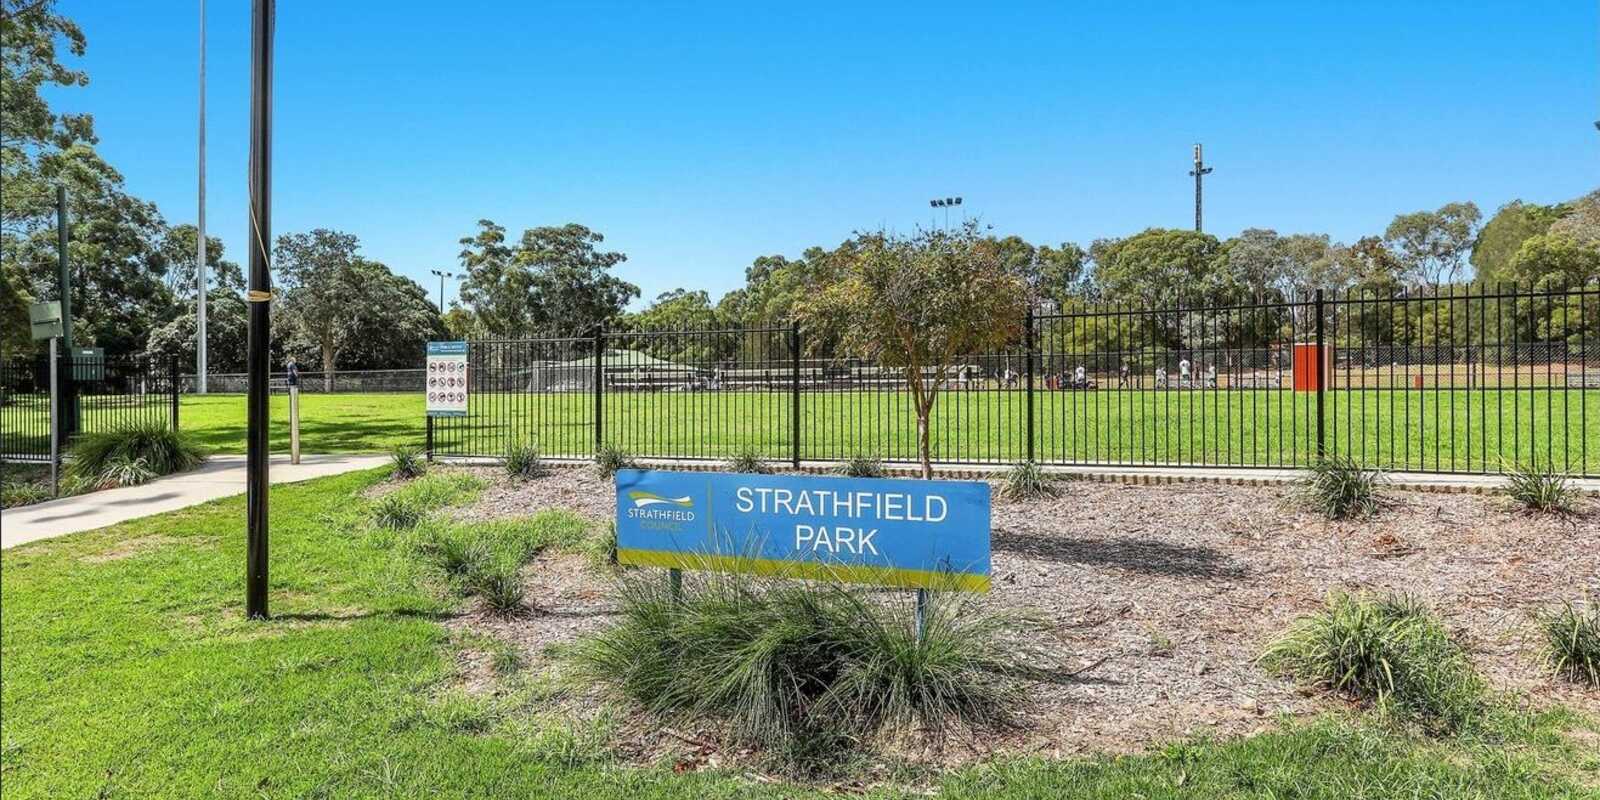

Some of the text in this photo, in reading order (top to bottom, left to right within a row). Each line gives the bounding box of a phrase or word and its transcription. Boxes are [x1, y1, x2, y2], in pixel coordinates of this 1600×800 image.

[627, 508, 695, 521] STRATHFIELD
[736, 486, 948, 522] STRATHFIELD
[795, 525, 878, 555] PARK
